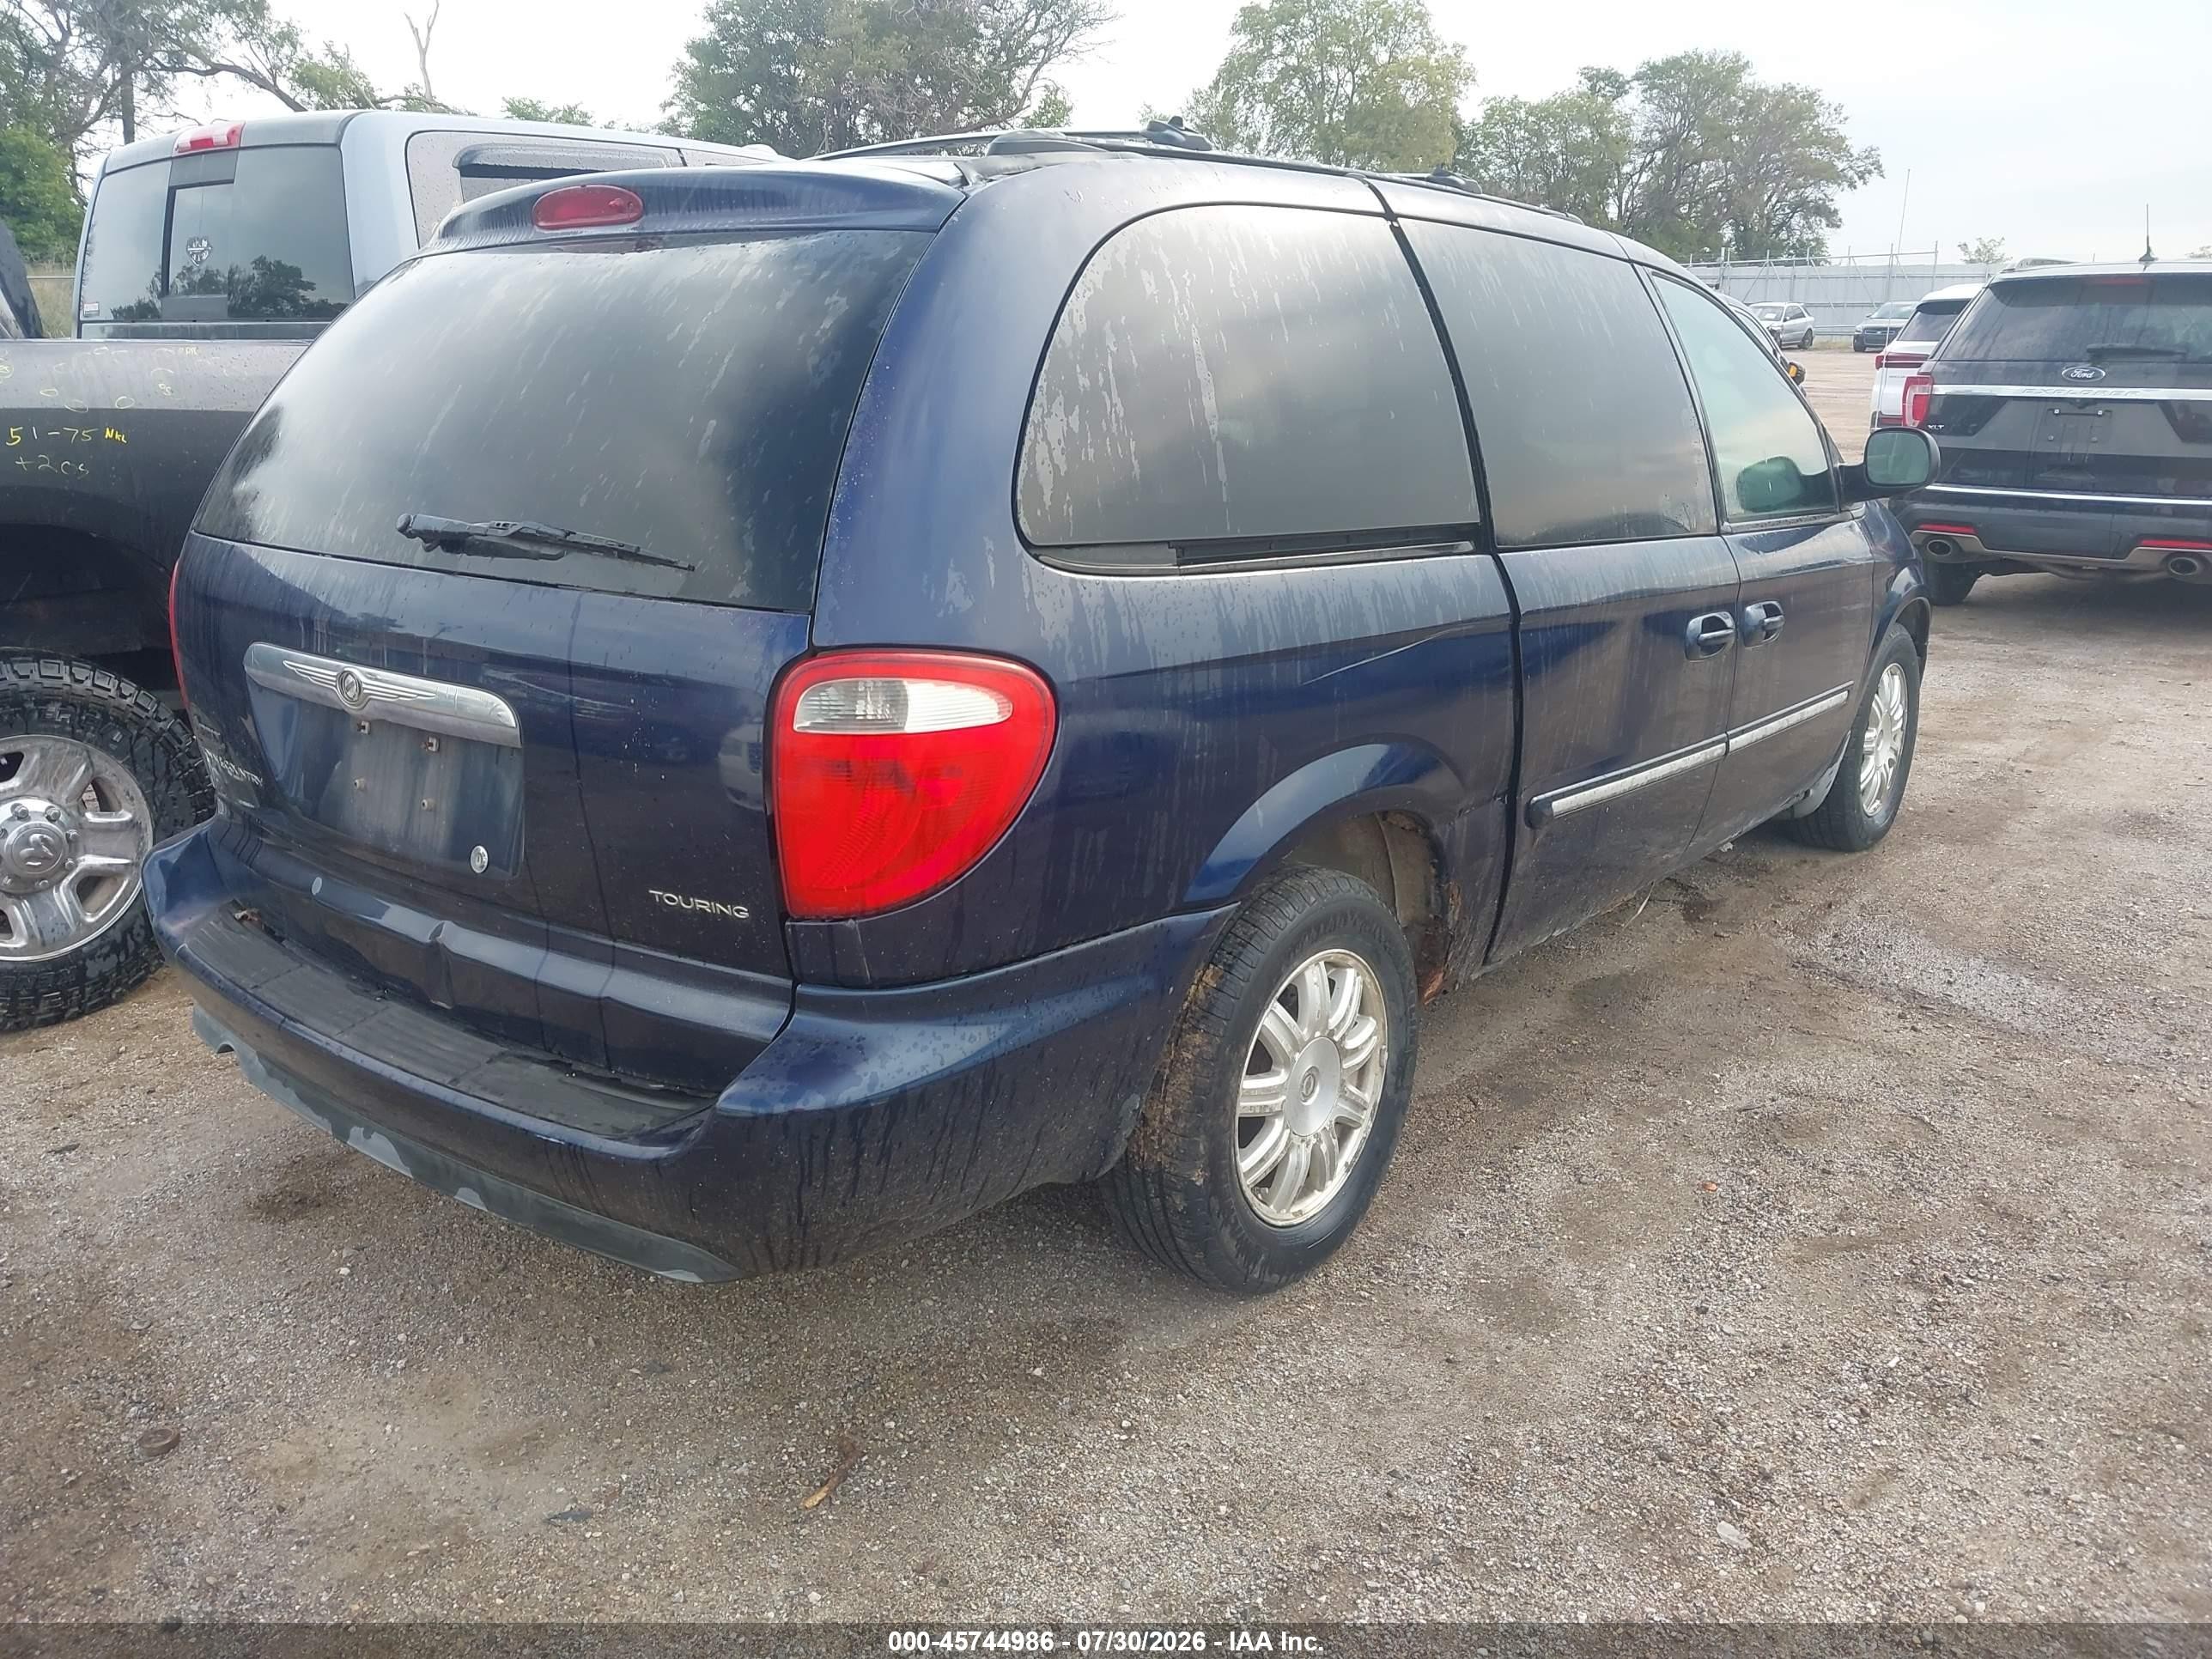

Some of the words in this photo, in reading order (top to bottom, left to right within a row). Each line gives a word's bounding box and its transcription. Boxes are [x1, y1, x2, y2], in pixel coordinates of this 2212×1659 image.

[2070, 368, 2095, 379] Ford
[2021, 387, 2142, 398] EXPLORER
[648, 890, 750, 919] TOURING
